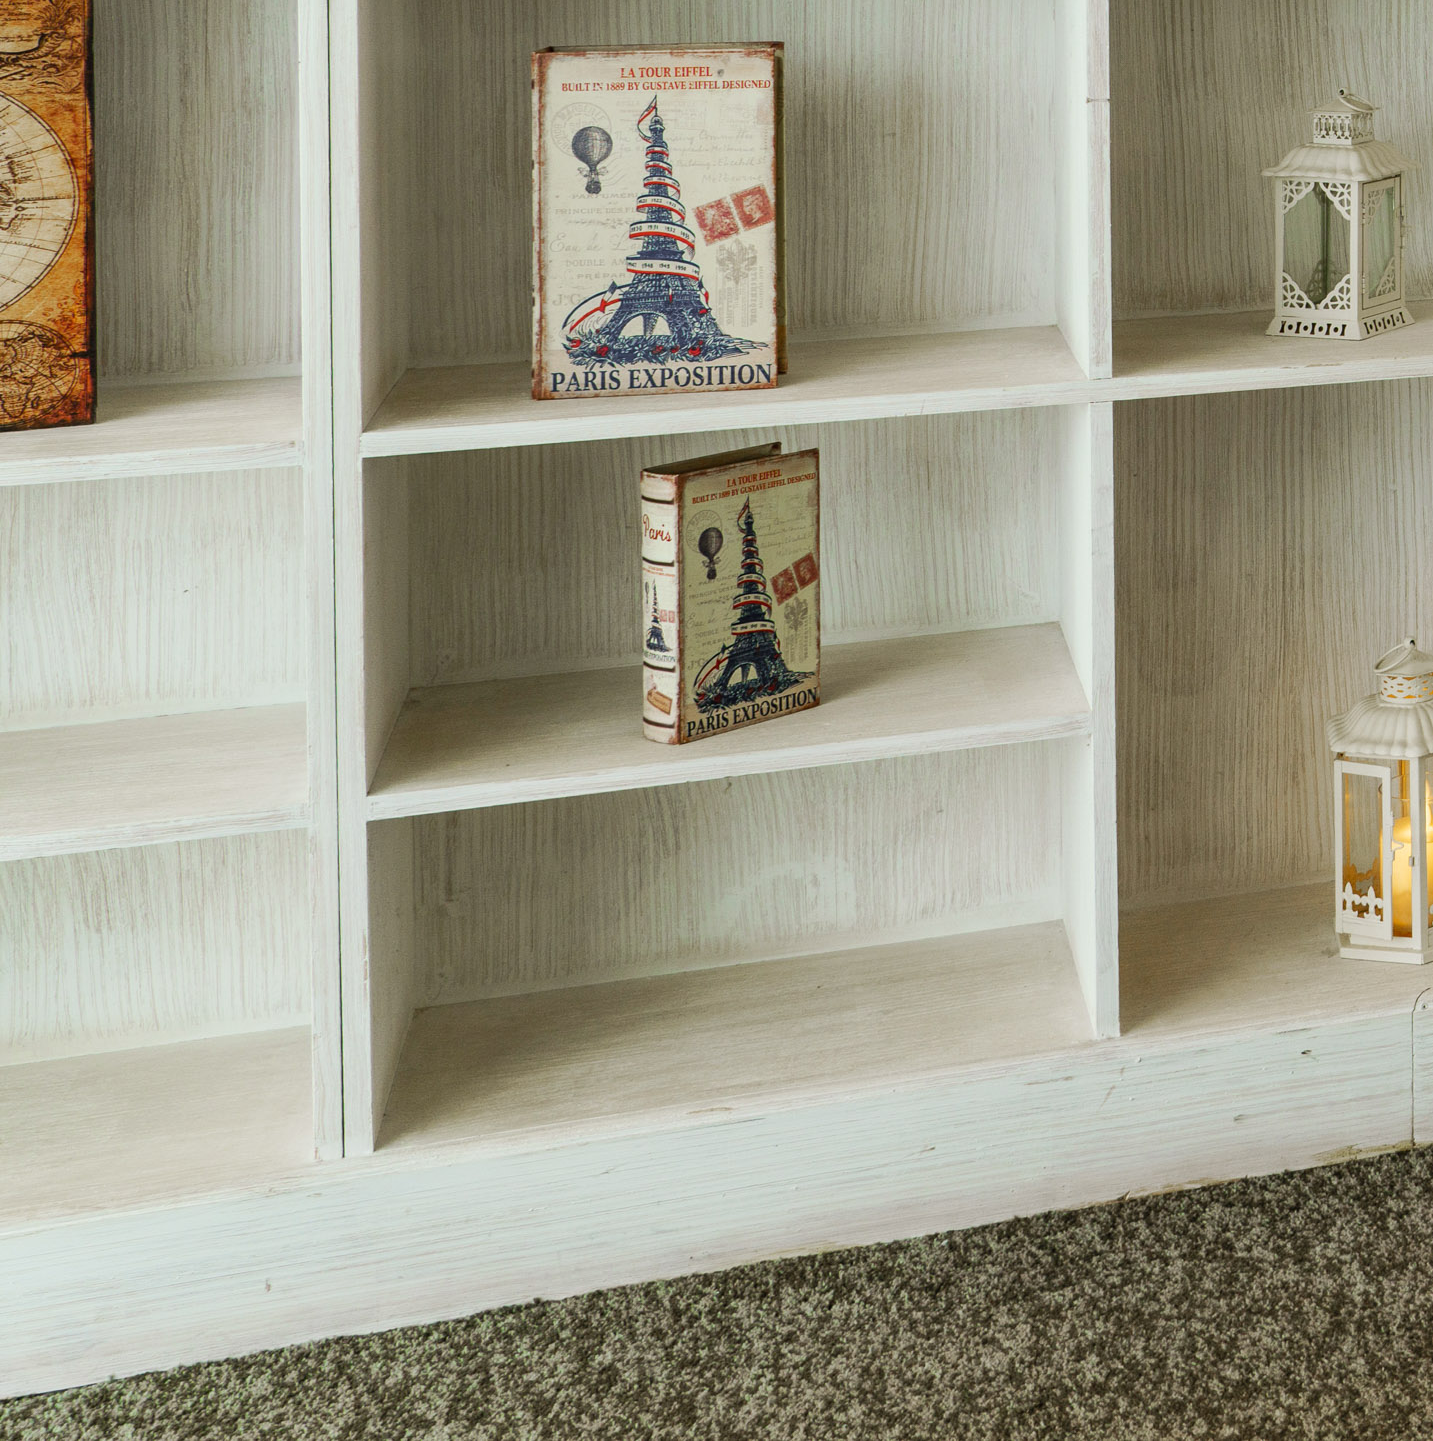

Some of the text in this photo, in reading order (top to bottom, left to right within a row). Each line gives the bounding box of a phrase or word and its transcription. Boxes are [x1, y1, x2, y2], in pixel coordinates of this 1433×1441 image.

[561, 82, 589, 92] BUILT
[606, 82, 625, 91] 1889
[627, 82, 640, 91] BY
[642, 81, 687, 91] GUSTAVE
[689, 80, 720, 90] EIFFEL
[722, 79, 771, 90] DESIGNED
[620, 66, 713, 78] LA TOUR EIFFEL
[550, 363, 773, 392] PARIS EXPOSITION
[692, 495, 709, 504] BUILT
[731, 488, 739, 496] BY
[740, 483, 766, 494] GUSTAVE
[787, 472, 816, 484] DESIGNED
[738, 473, 758, 485] TOUR
[758, 469, 782, 481] EIFFEL
[642, 513, 672, 542] Paris
[686, 687, 818, 737] PARIS EXPOSITION
